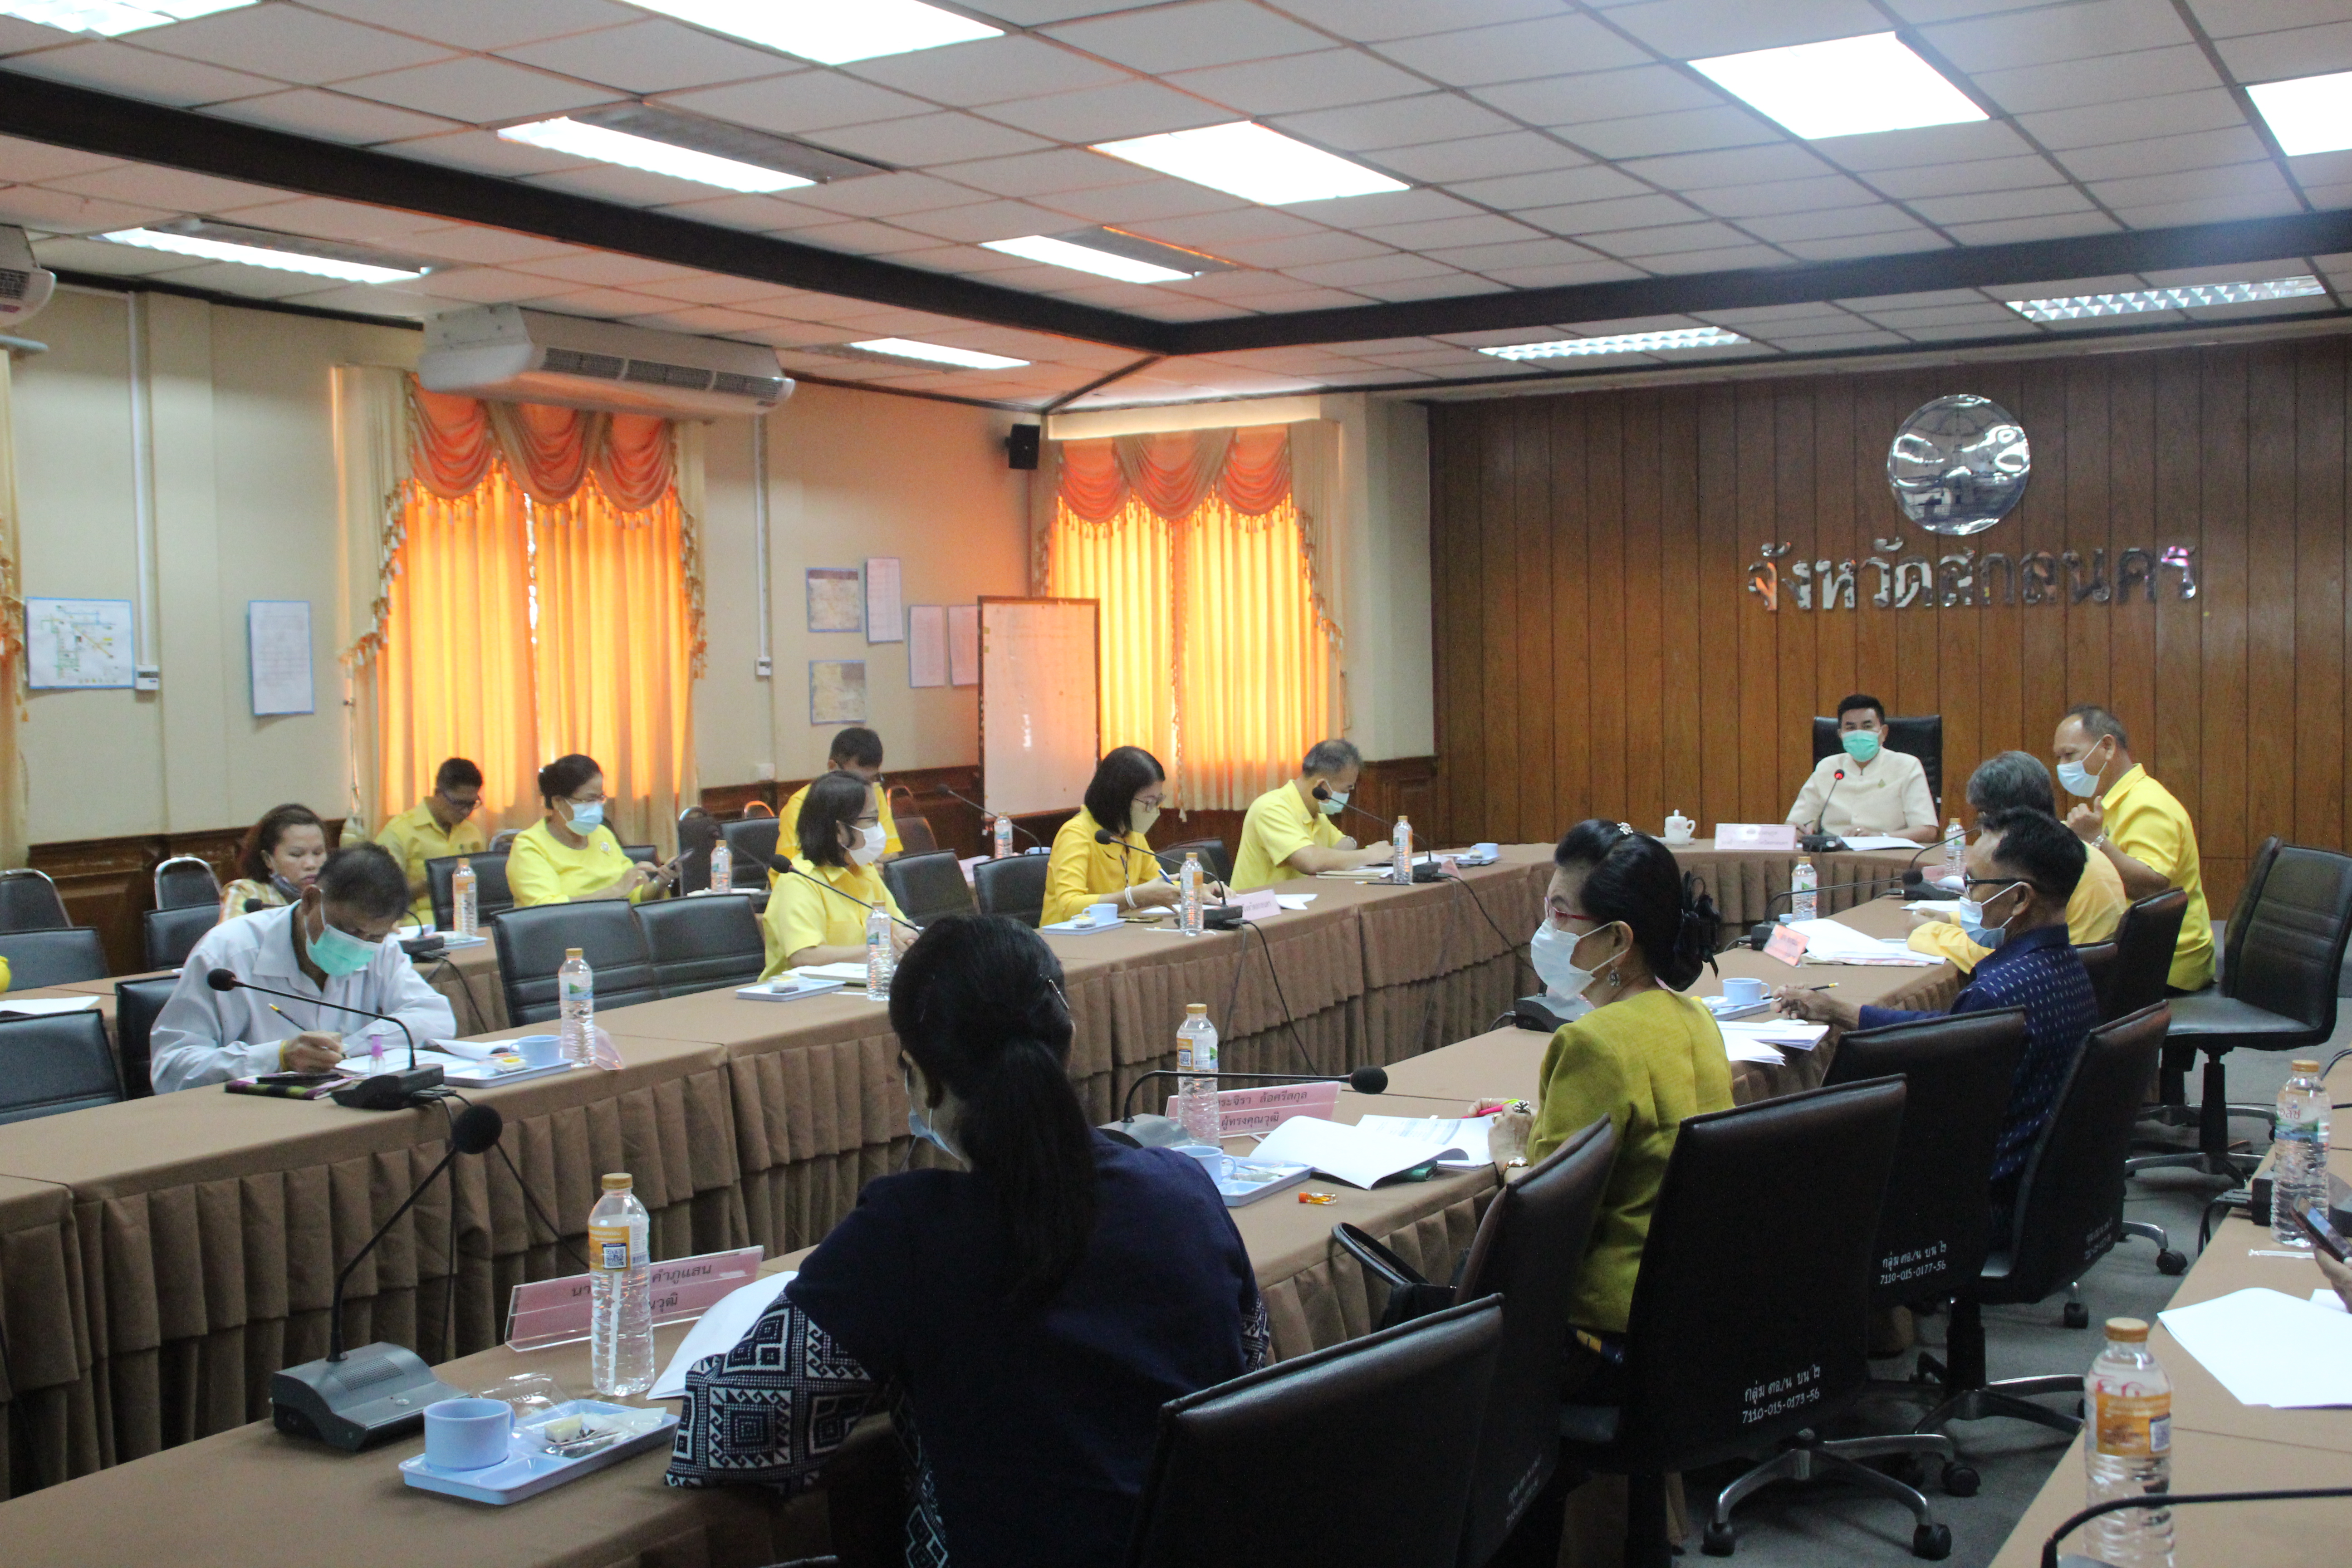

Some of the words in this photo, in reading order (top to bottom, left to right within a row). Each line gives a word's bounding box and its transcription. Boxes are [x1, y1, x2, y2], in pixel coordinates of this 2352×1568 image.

[1748, 536, 2196, 611] จังหวัดสกลนคร
[1221, 1112, 1279, 1130] ผู้ทรงคุณวุฒิ
[1880, 1259, 1946, 1284] 7110-015-0177-56
[1744, 1380, 1765, 1405] กลุ่ม
[1742, 1387, 1820, 1424] 7110-015-0173-56
